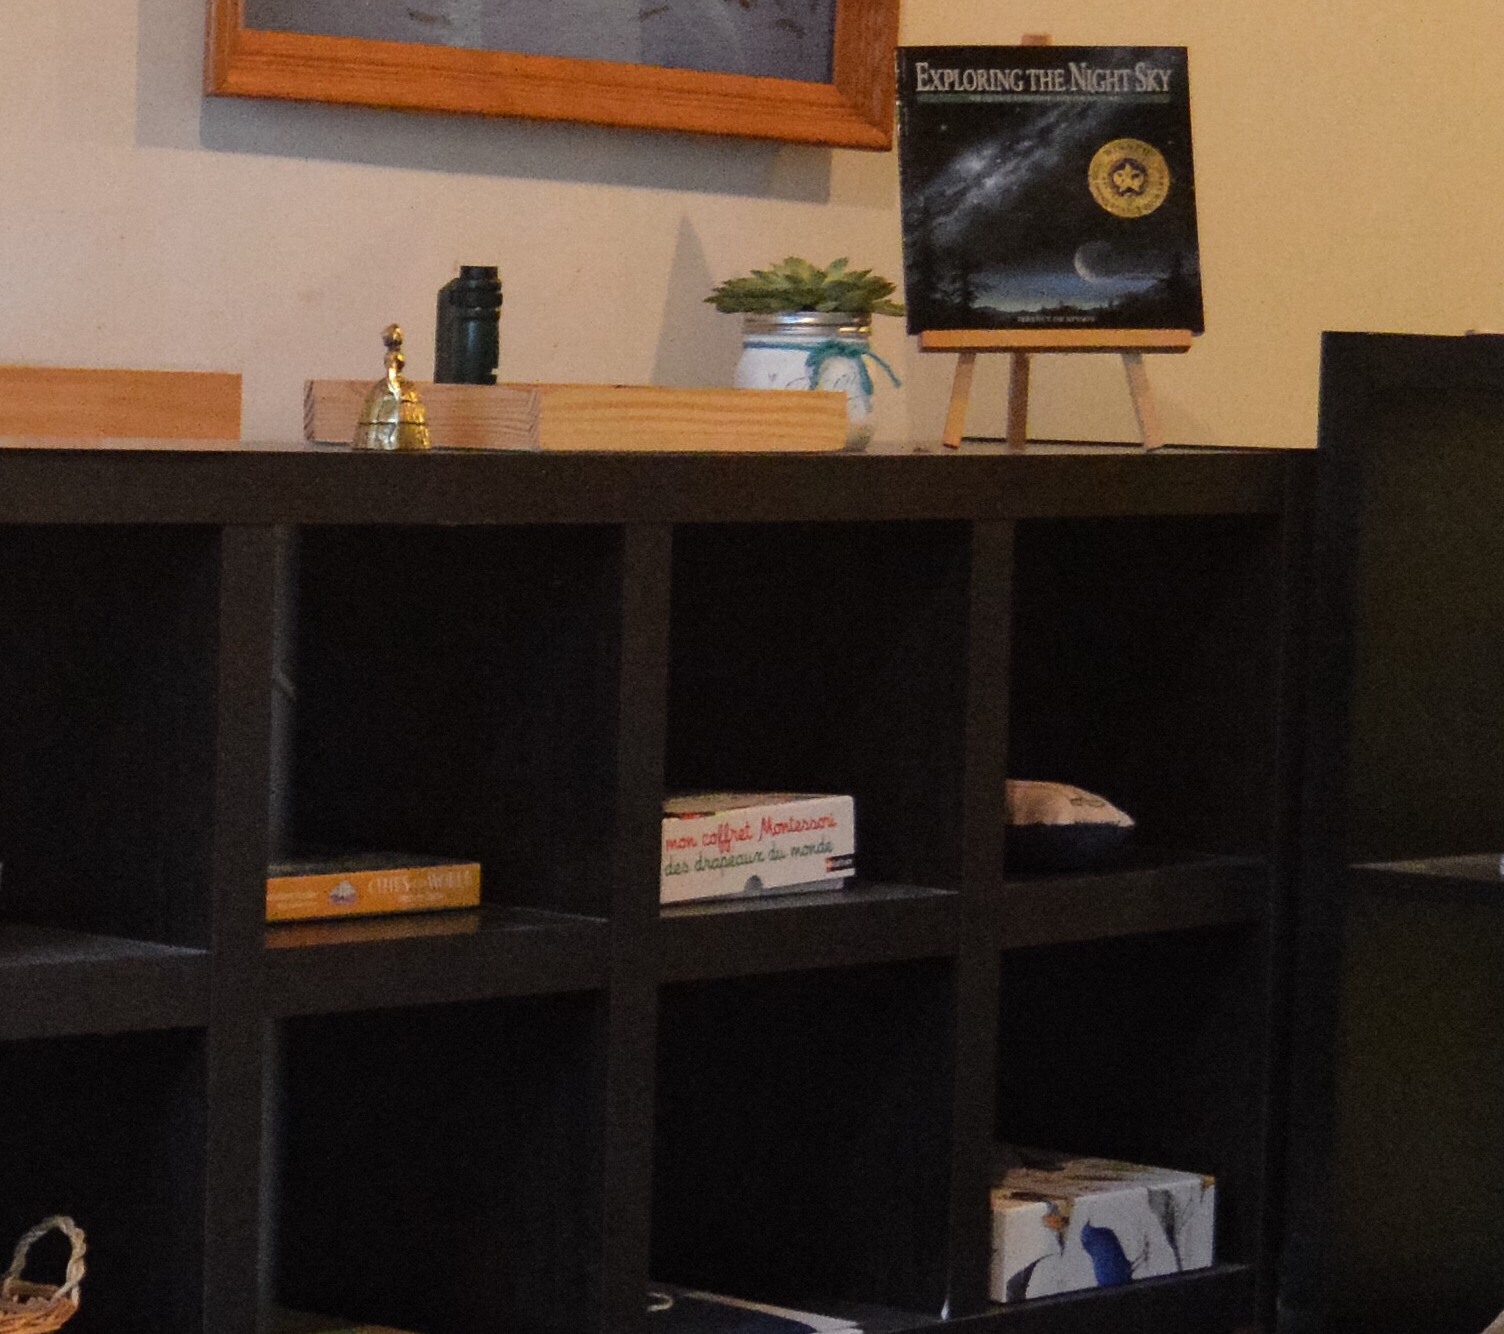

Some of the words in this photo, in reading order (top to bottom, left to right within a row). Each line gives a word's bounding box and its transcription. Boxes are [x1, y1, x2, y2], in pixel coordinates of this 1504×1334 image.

[915, 61, 1023, 92] EXPLORING
[1026, 68, 1067, 92] THE
[1068, 61, 1133, 93] NIGHT
[1134, 61, 1174, 92] SKY
[665, 837, 697, 853] mon
[701, 821, 753, 854] coffret
[757, 814, 838, 842] Montessori
[664, 856, 689, 877] des
[694, 851, 765, 877] drapeaux
[768, 841, 789, 861] du
[791, 837, 833, 857] monde
